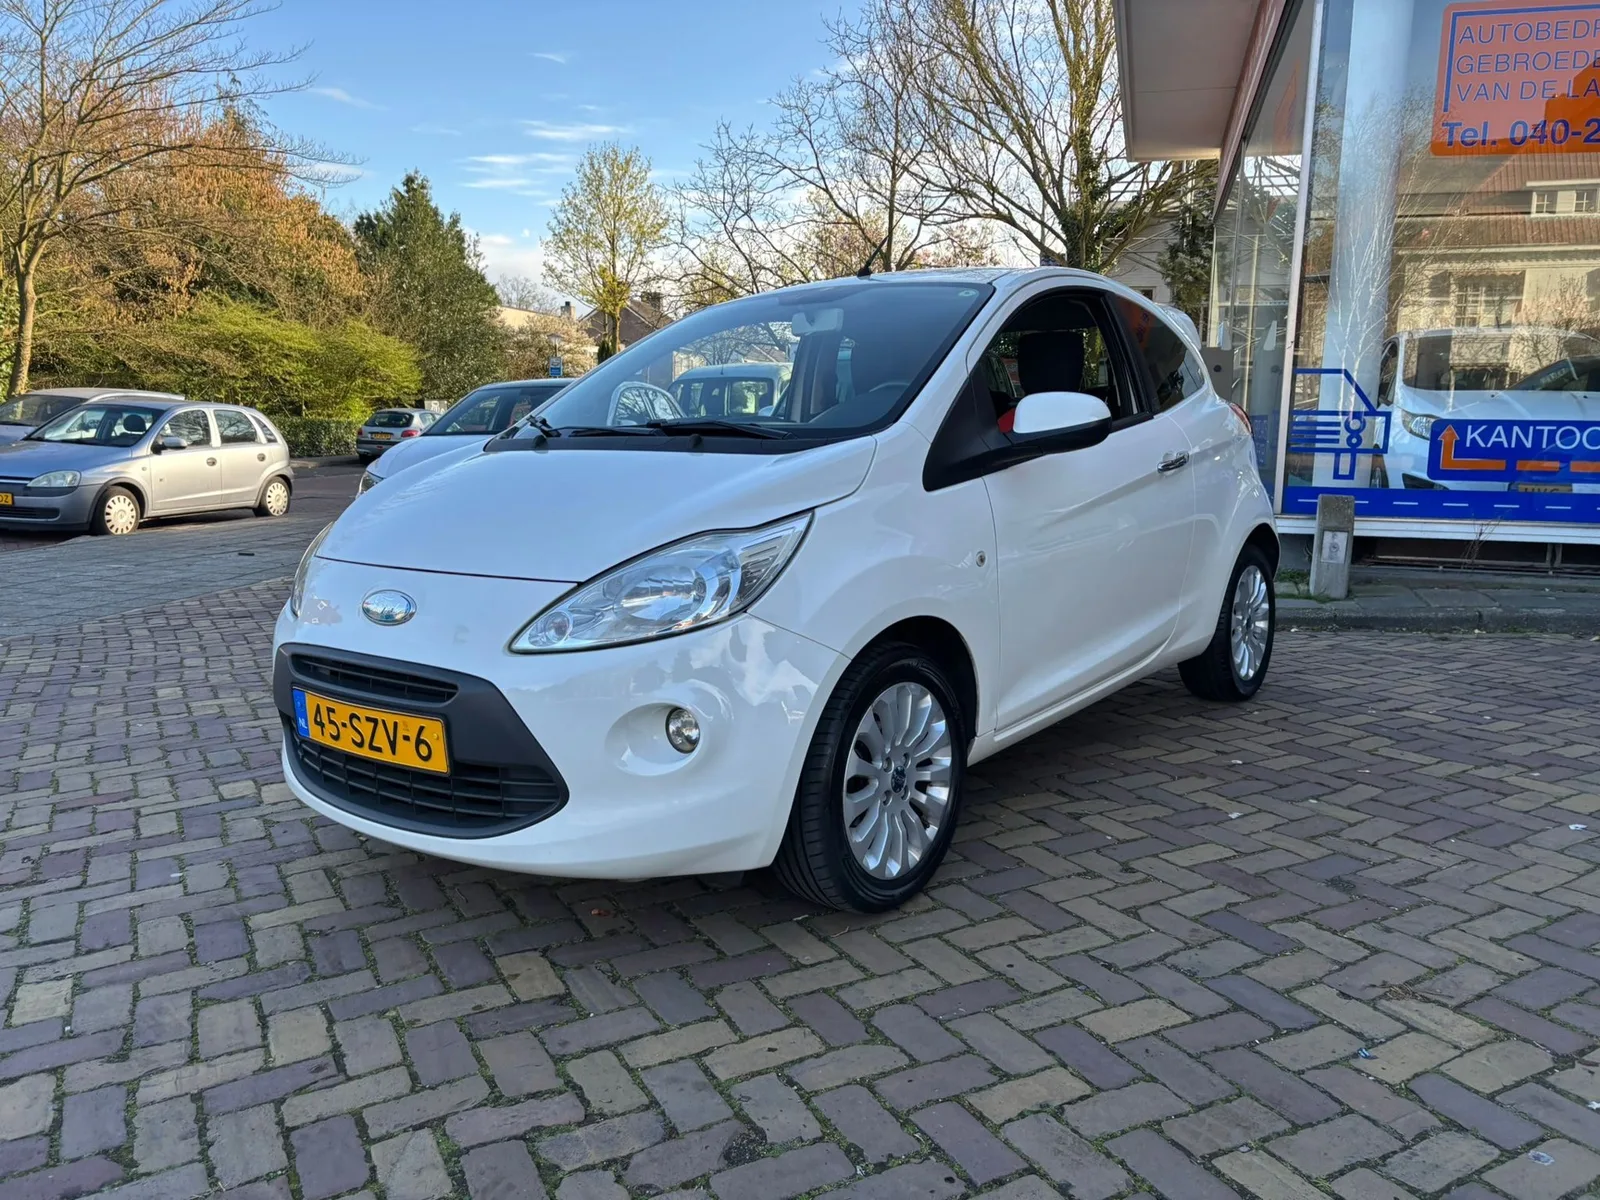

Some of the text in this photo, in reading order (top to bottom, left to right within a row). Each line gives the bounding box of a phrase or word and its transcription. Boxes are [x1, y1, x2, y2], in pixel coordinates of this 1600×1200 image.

[1456, 78, 1600, 102] VAN DE LA
[1441, 117, 1600, 147] Tel. 040-2
[1465, 424, 1600, 450] KANTOO
[298, 717, 308, 729] NL
[313, 703, 433, 762] 45-SZV-6
